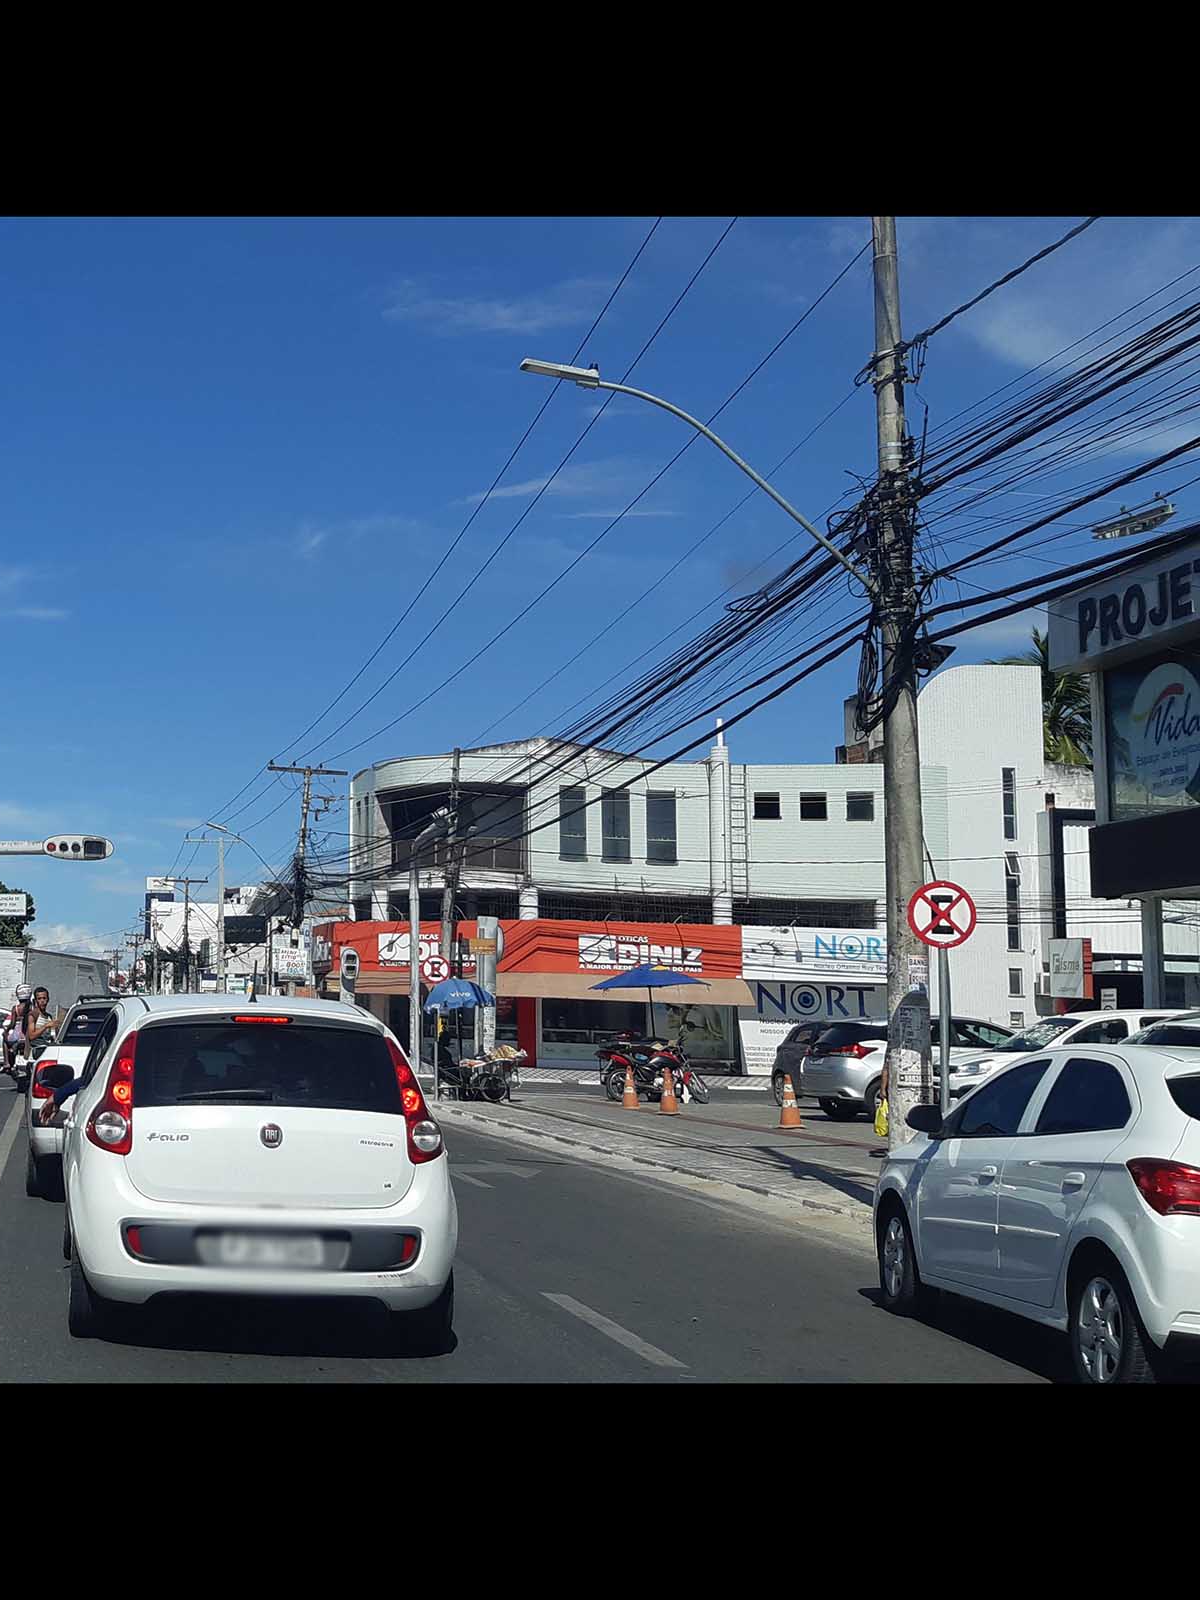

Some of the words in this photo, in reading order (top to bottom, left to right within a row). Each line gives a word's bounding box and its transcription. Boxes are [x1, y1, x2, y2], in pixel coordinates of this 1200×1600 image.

[618, 943, 703, 967] DINIZ
[814, 934, 887, 961] NOR
[449, 990, 472, 998] vivo
[756, 982, 876, 1018] NORT
[264, 1129, 278, 1141] FIAT
